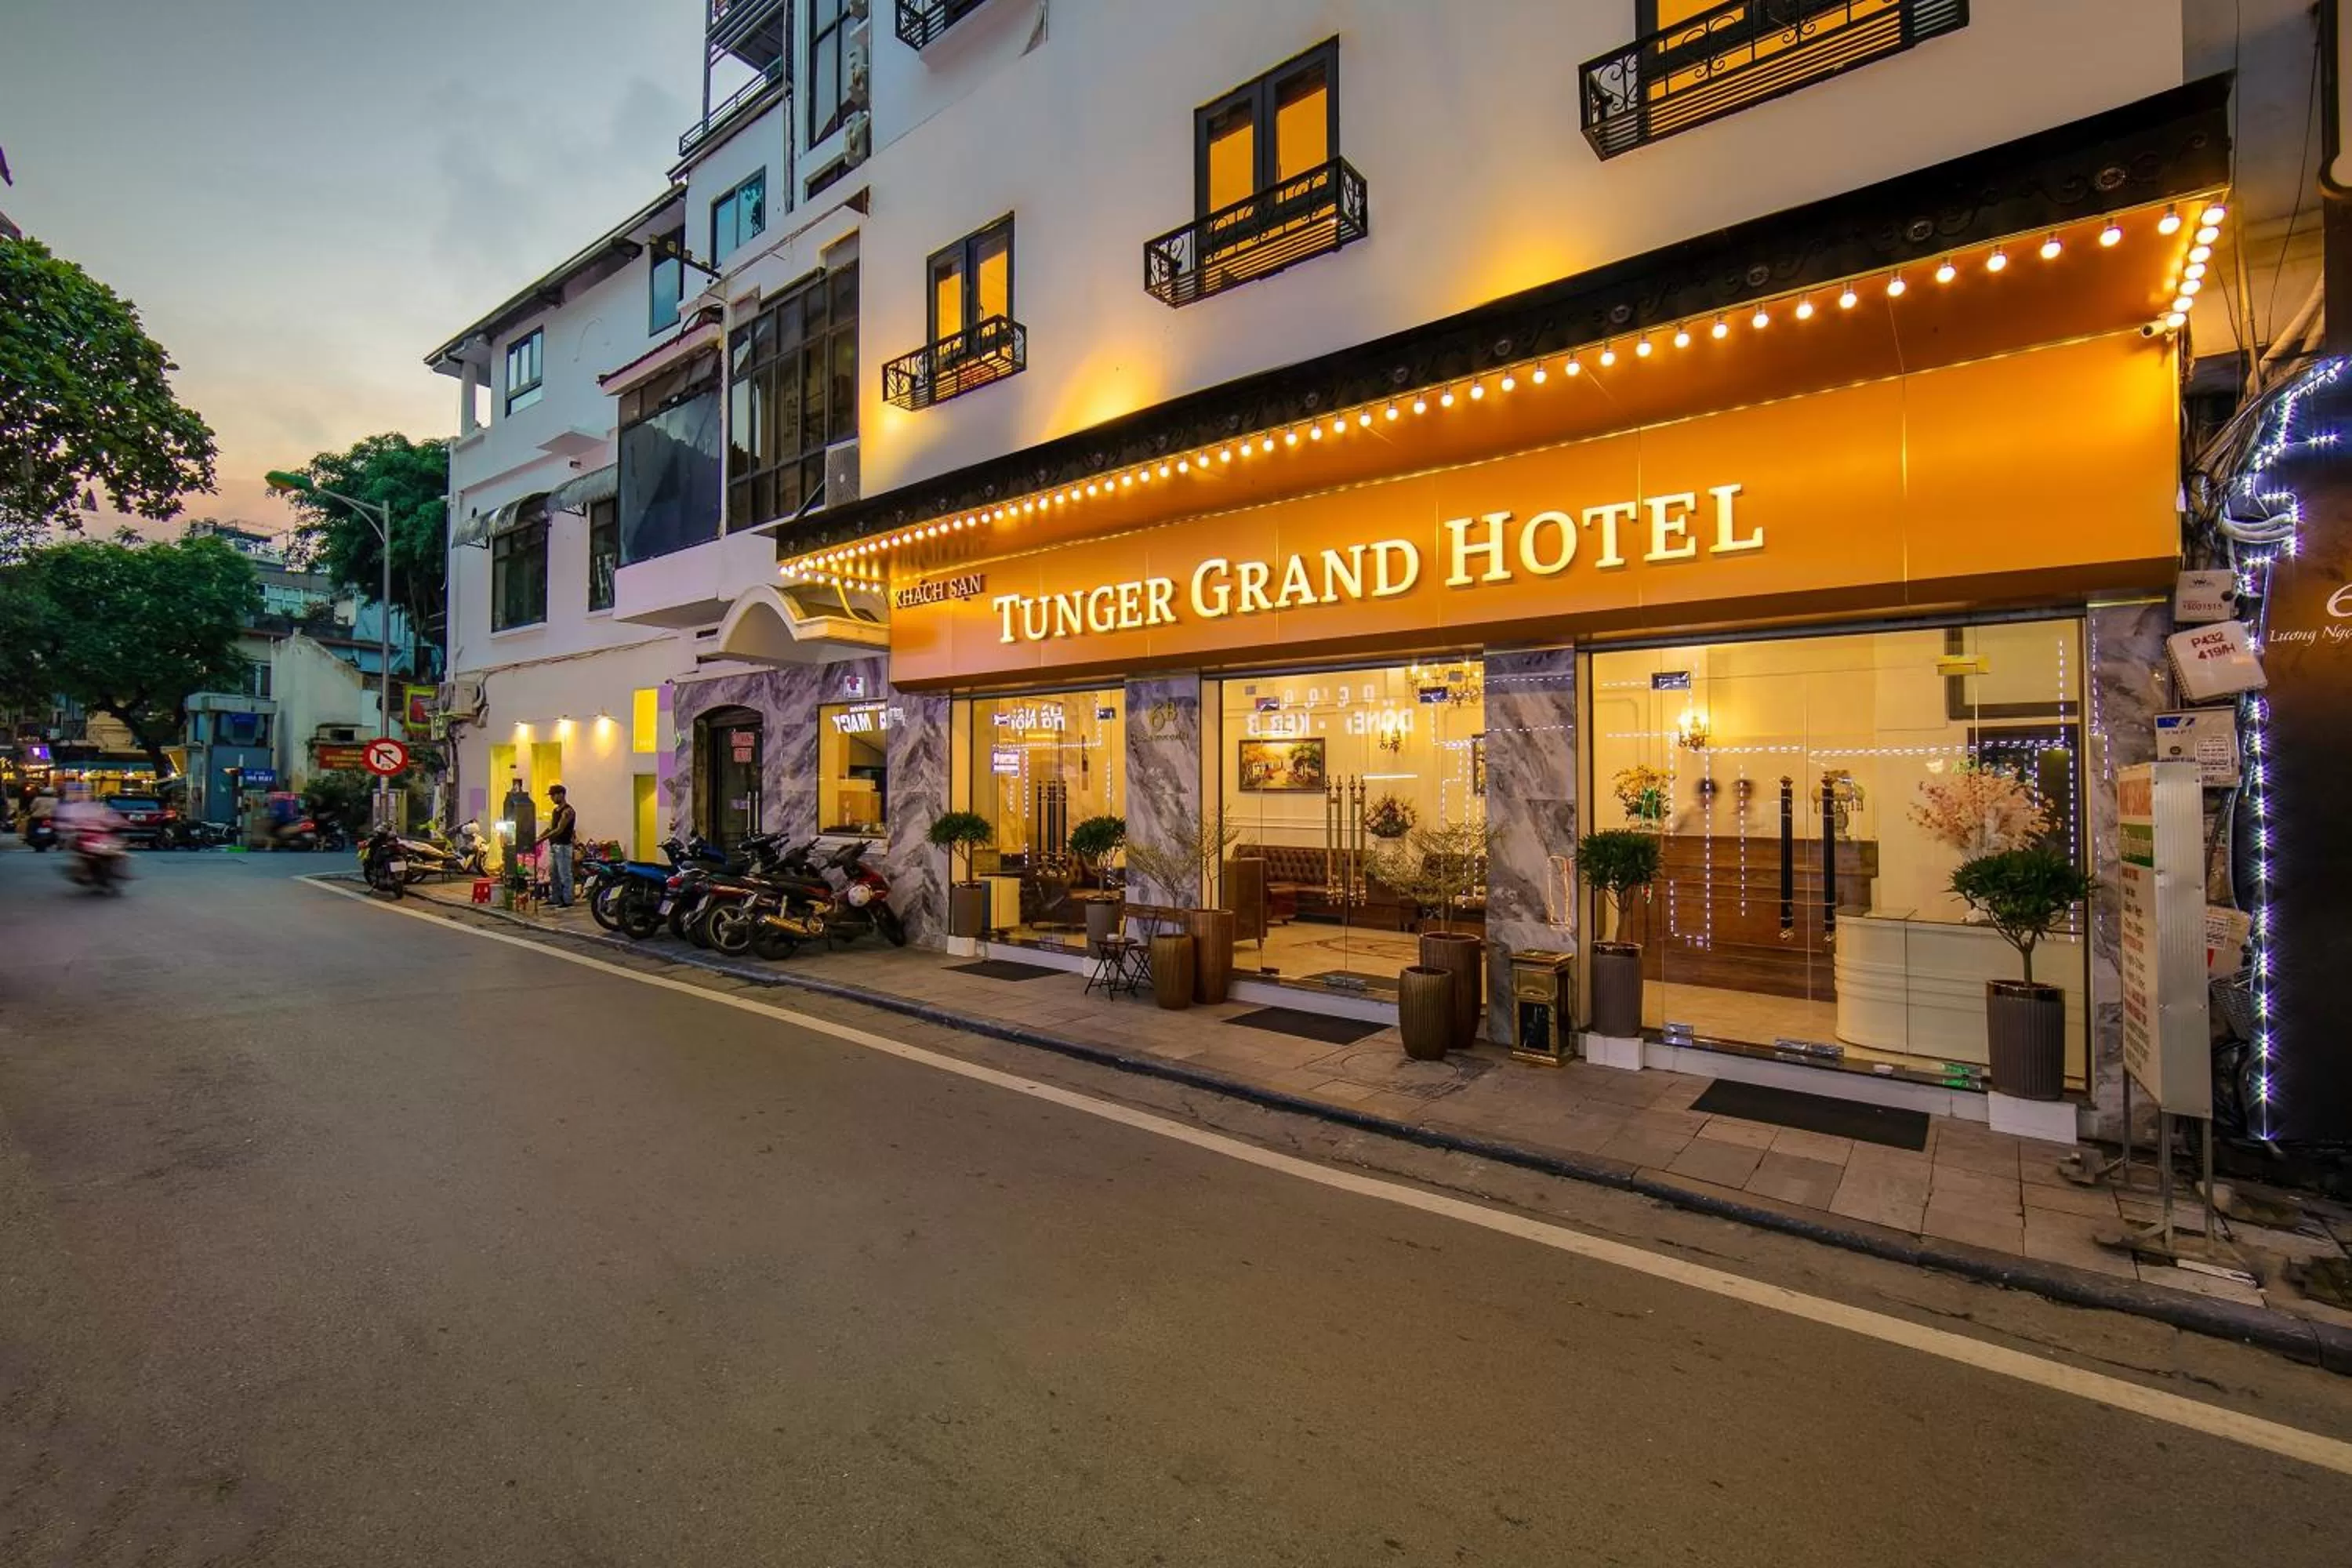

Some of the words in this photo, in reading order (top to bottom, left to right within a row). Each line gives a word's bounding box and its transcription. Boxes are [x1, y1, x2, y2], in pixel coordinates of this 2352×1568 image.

[993, 577, 1176, 643] TUNGER
[1191, 539, 1420, 619] GRAND
[1444, 483, 1763, 587] HOTEL
[895, 579, 944, 606] KHÁCH
[2191, 631, 2224, 648] P432
